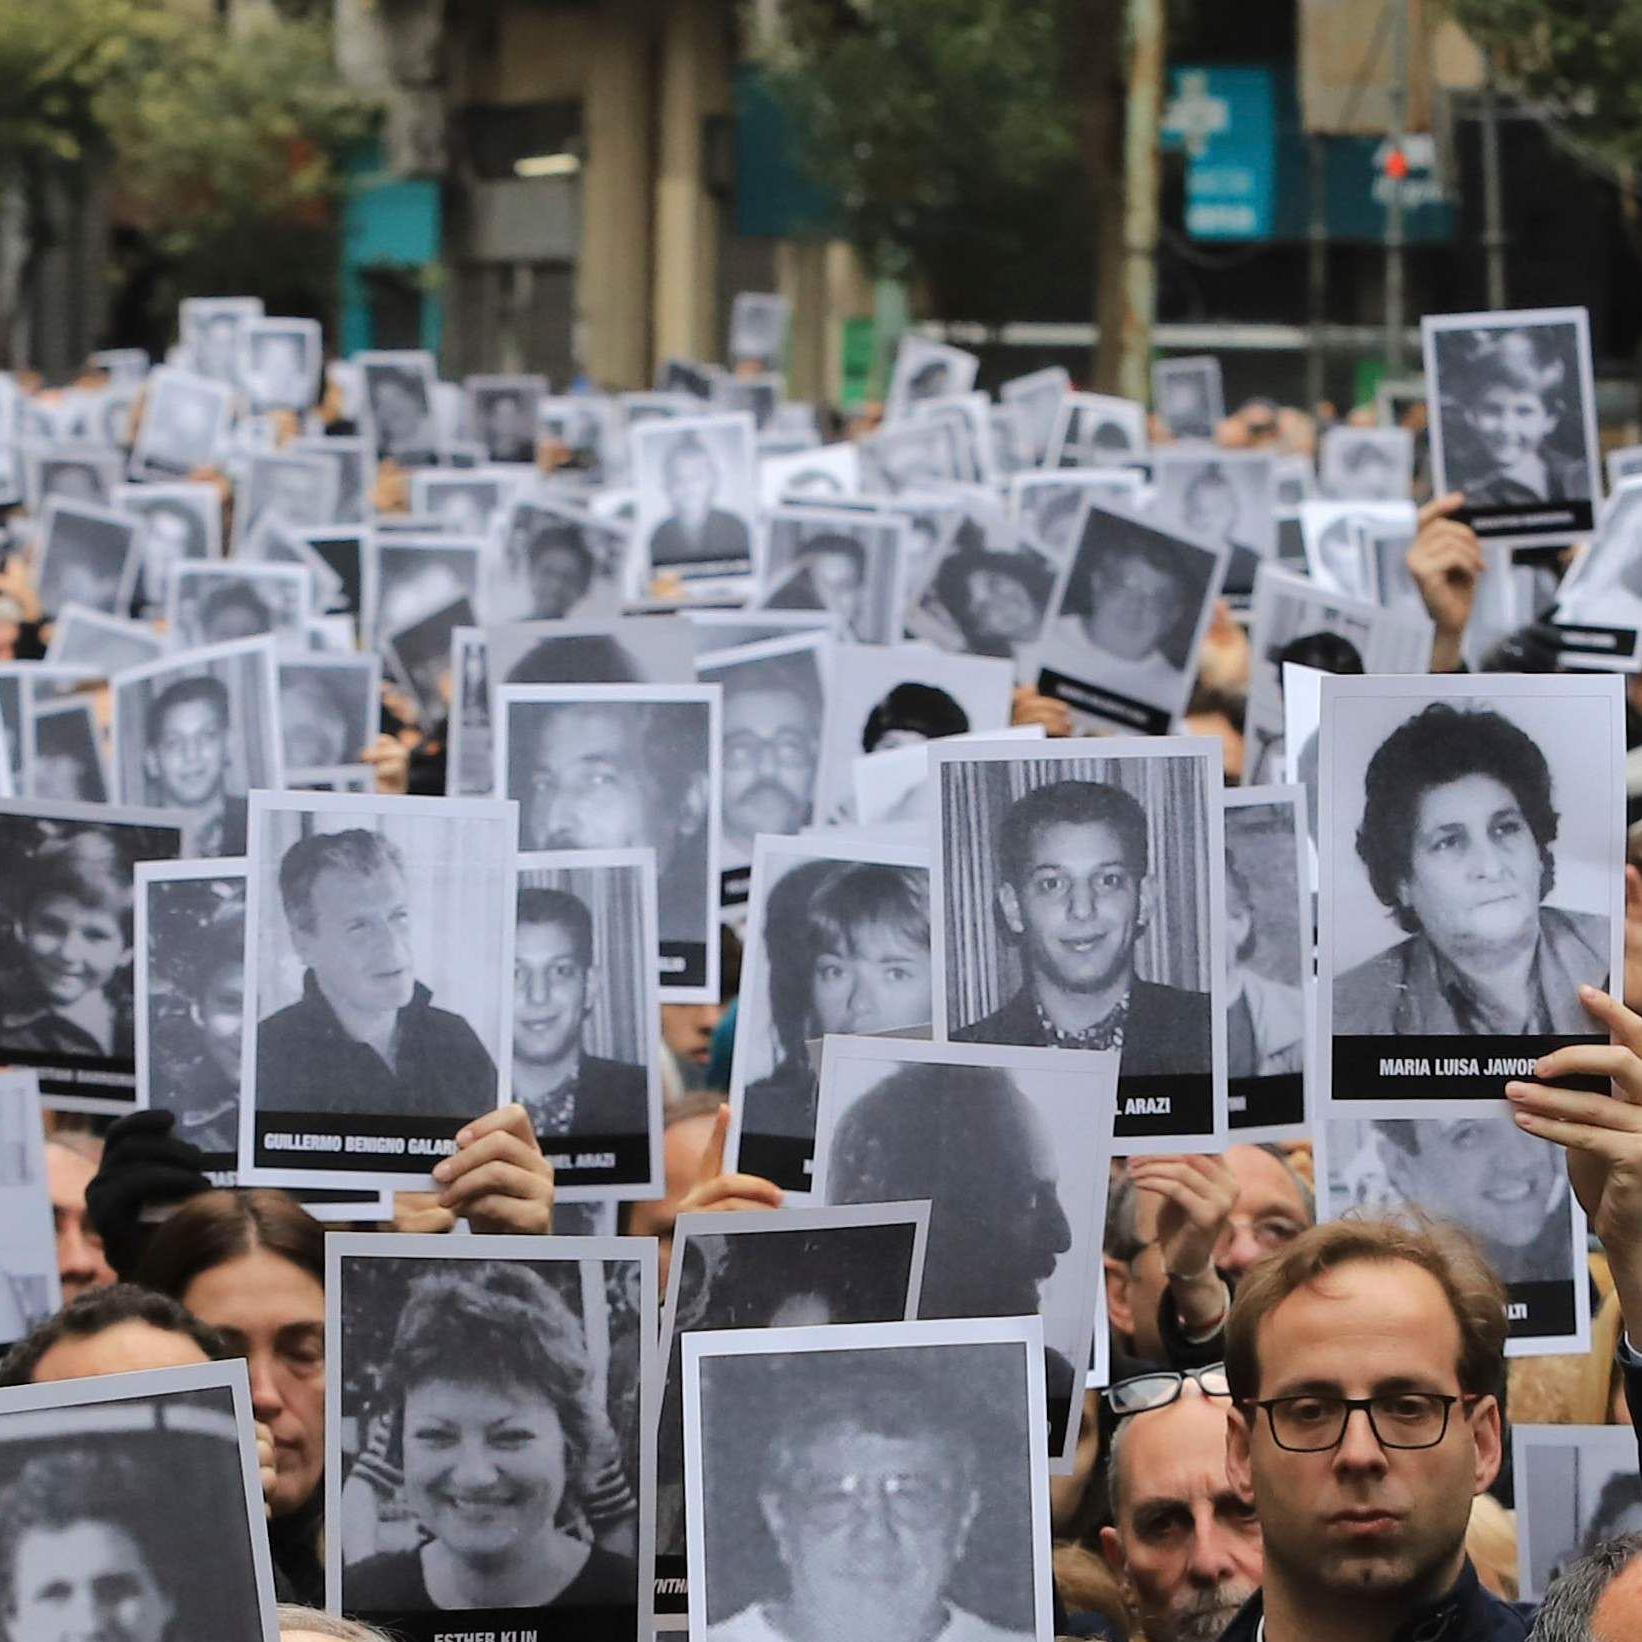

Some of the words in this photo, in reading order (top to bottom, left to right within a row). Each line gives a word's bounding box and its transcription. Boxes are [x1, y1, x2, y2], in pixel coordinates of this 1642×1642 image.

[1379, 1058, 1431, 1076] MARIA
[1435, 1058, 1480, 1076] LUISA
[1124, 1097, 1171, 1115] ARAZI
[263, 1132, 342, 1152] GUILLERMO
[344, 1135, 405, 1154] BENIGNO
